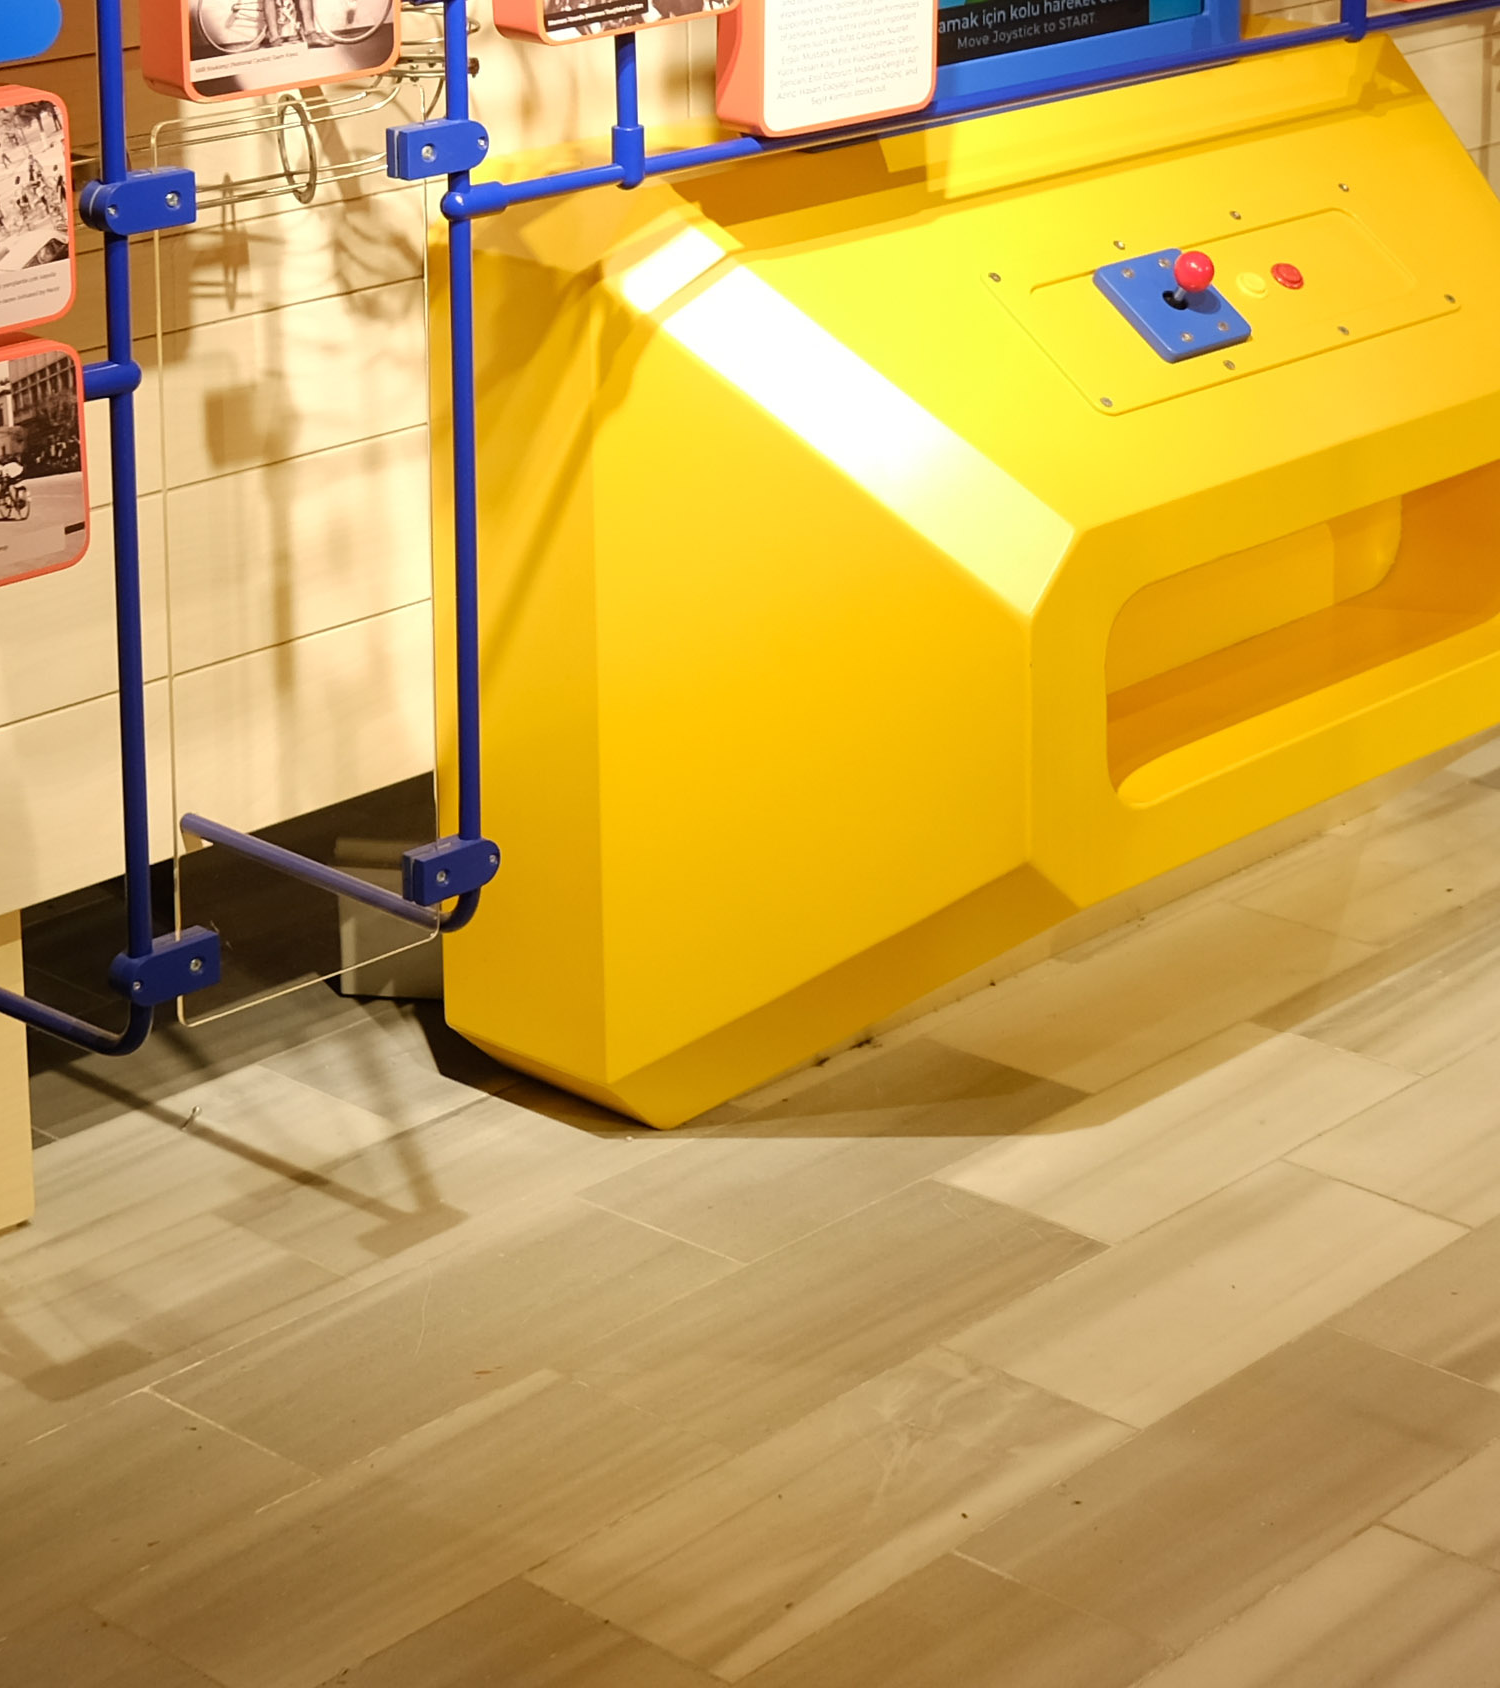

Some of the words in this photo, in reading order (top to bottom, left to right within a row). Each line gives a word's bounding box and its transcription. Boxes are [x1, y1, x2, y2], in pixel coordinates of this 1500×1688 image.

[938, 12, 979, 34] amak
[981, 6, 1007, 28] için
[1009, 0, 1041, 21] kolu
[957, 33, 990, 50] Move
[992, 23, 1041, 44] Joystick
[1043, 20, 1056, 33] to
